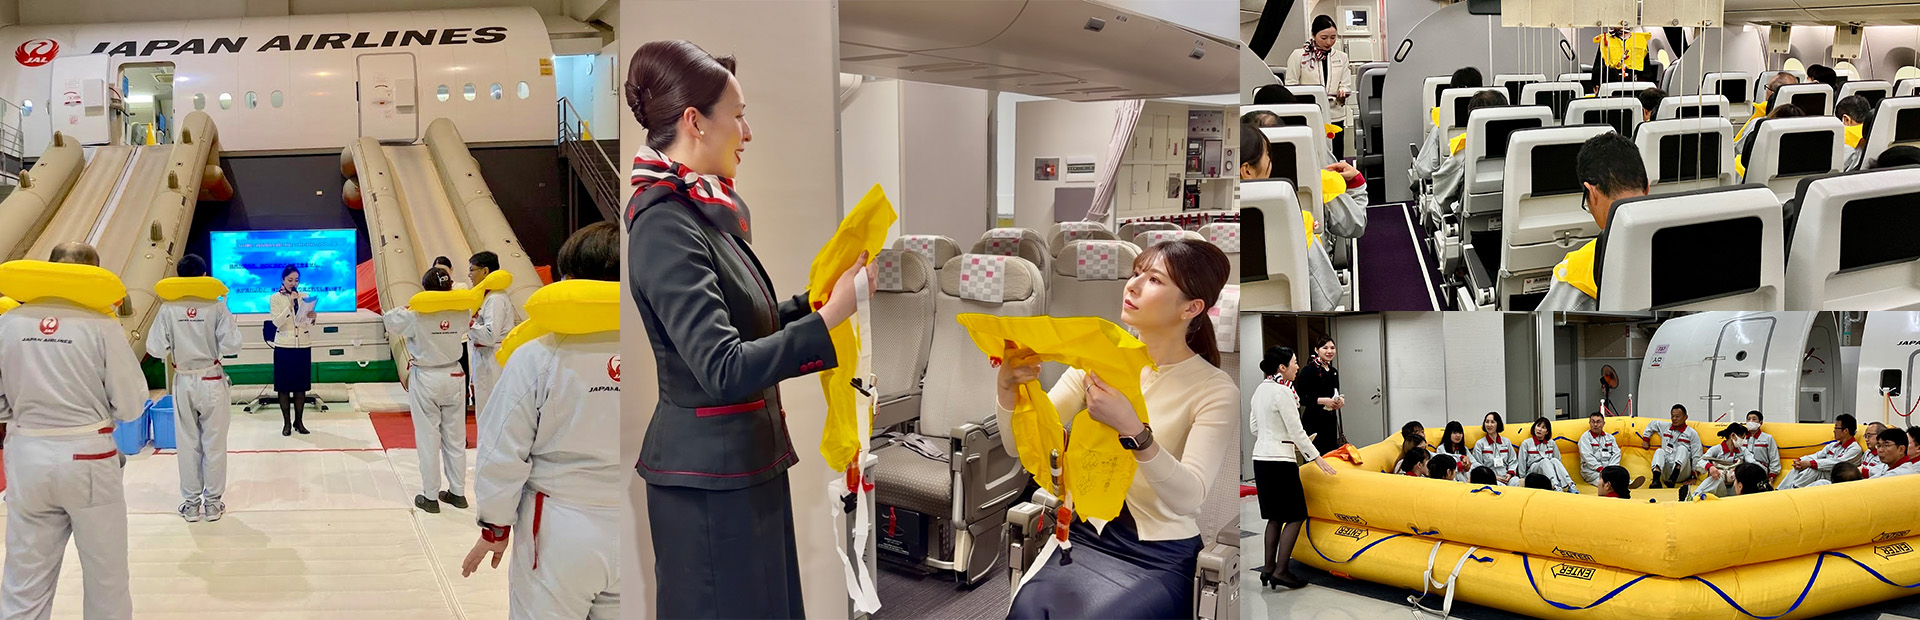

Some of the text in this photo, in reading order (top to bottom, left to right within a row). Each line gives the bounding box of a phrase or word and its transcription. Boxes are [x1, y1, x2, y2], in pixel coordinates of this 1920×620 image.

[90, 26, 508, 57] JAPAN AIRLINES
[1559, 565, 1592, 578] ENTER
